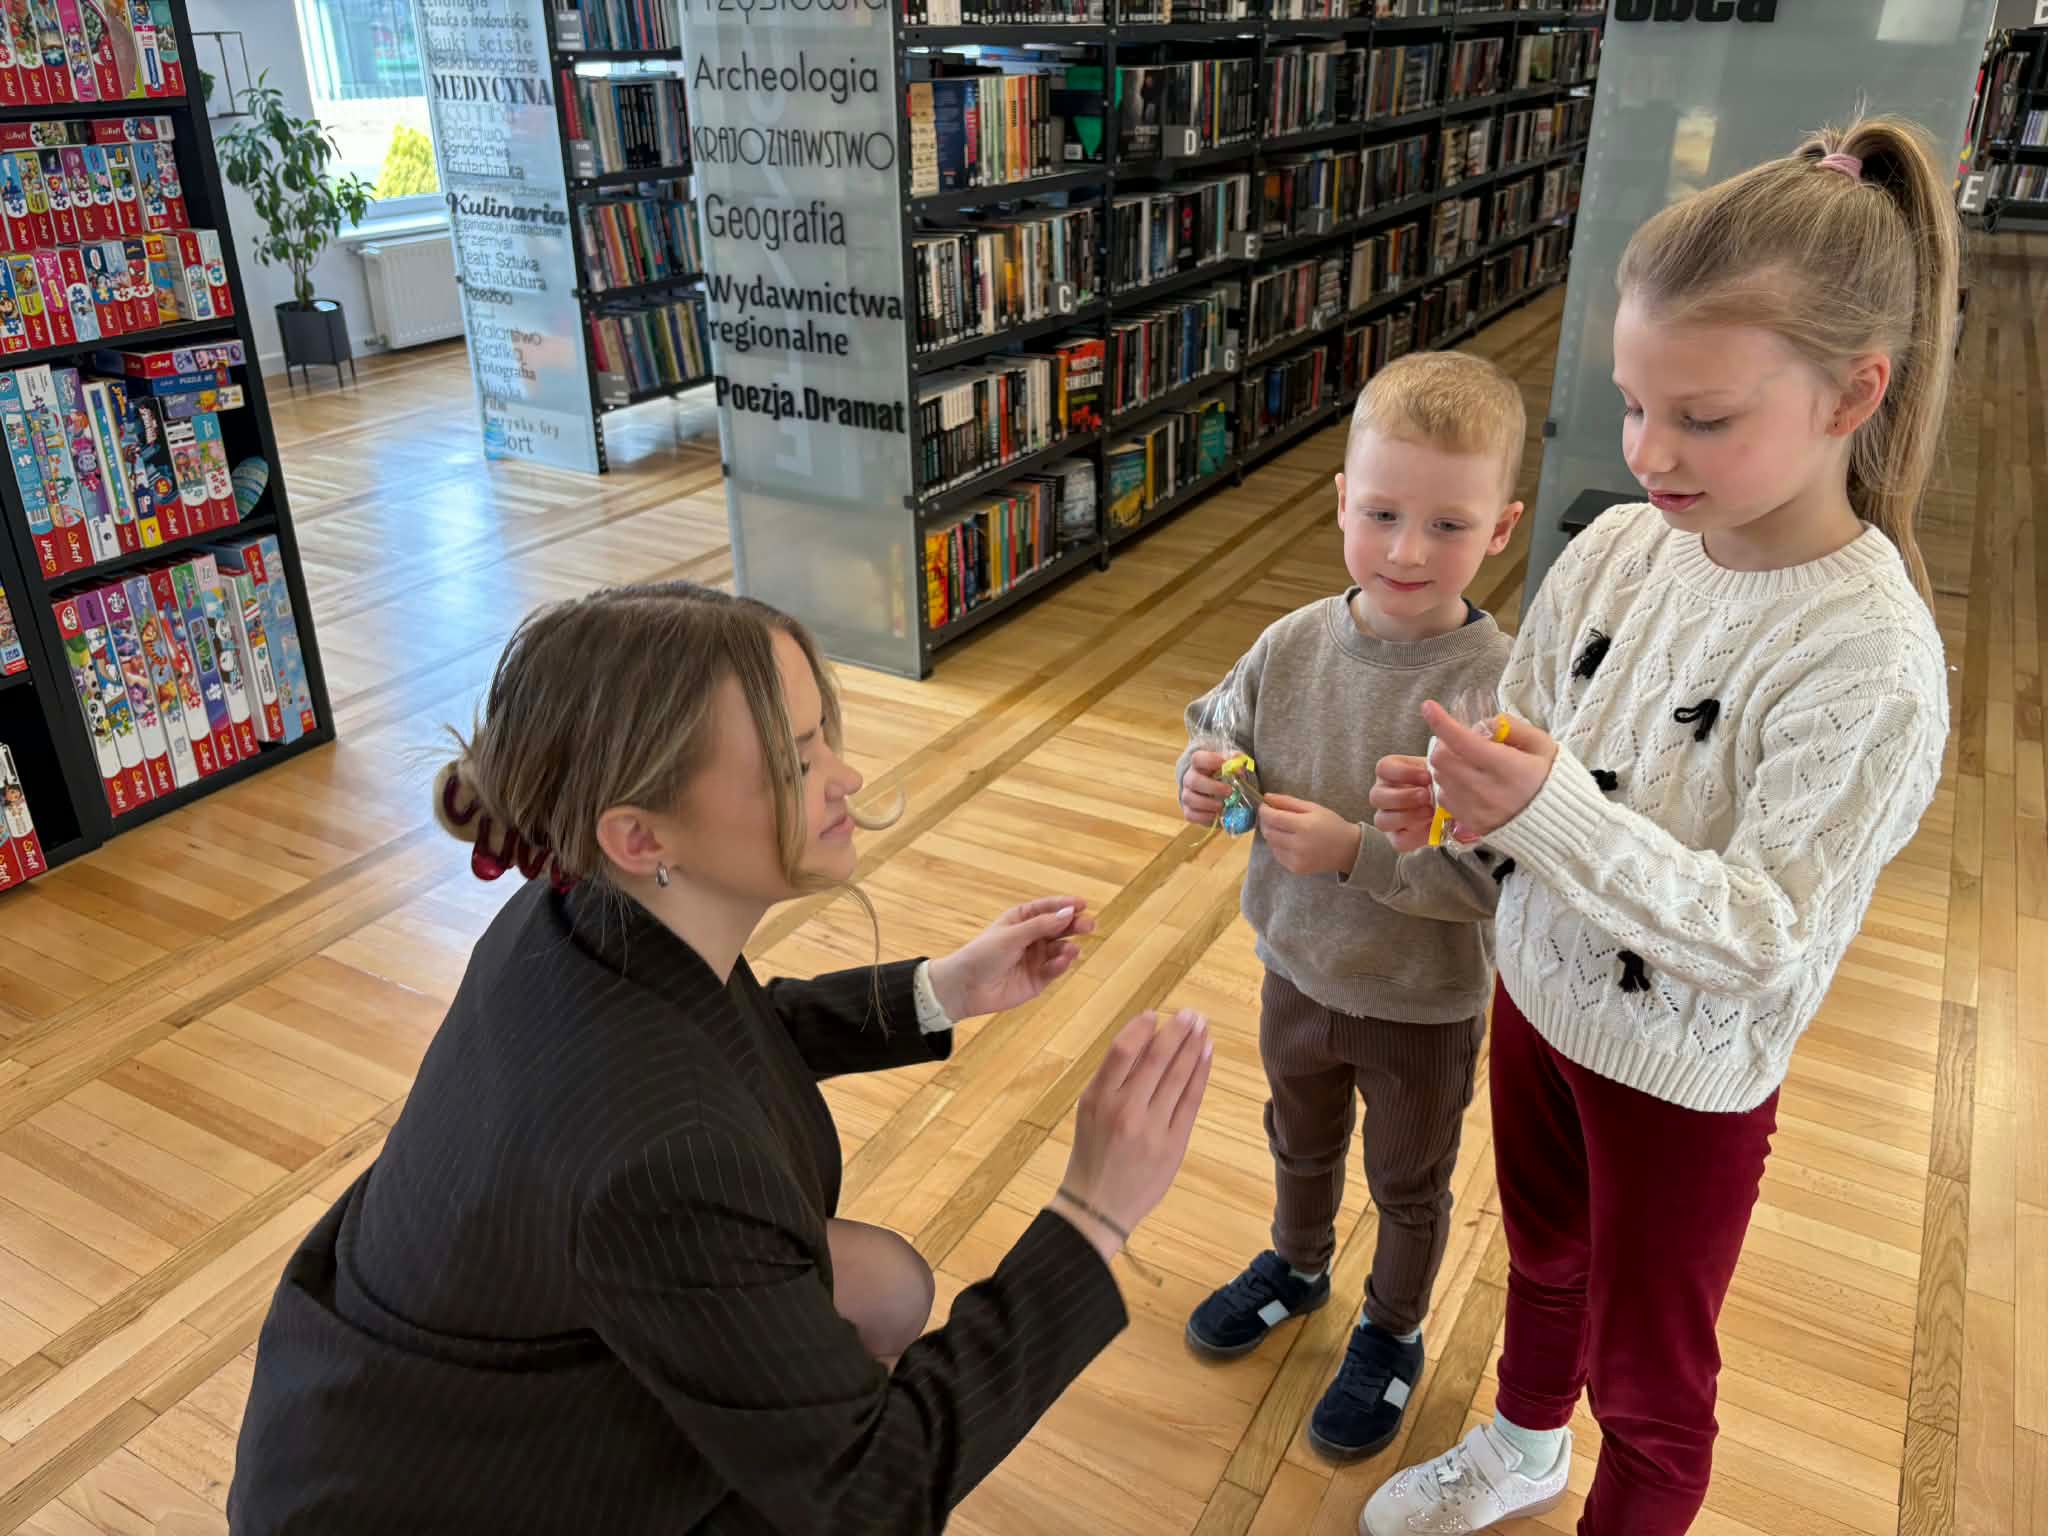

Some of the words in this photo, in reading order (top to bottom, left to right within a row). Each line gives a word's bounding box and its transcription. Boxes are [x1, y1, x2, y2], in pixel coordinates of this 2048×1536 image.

[432, 74, 553, 106] MEDYCYNA
[694, 51, 878, 104] Archeologia
[692, 126, 896, 170] KRAJOZNAWSTWO
[1184, 129, 1197, 155] D
[446, 192, 568, 225] Kulinaria
[1961, 175, 1985, 209] E
[705, 193, 847, 251] Geografia
[1245, 234, 1257, 258] E
[705, 272, 903, 320] Wydawnictwa
[1059, 285, 1071, 313] C
[709, 316, 848, 356] regionalne
[1224, 349, 1236, 371] G
[716, 375, 905, 434] Poezja.Dramat
